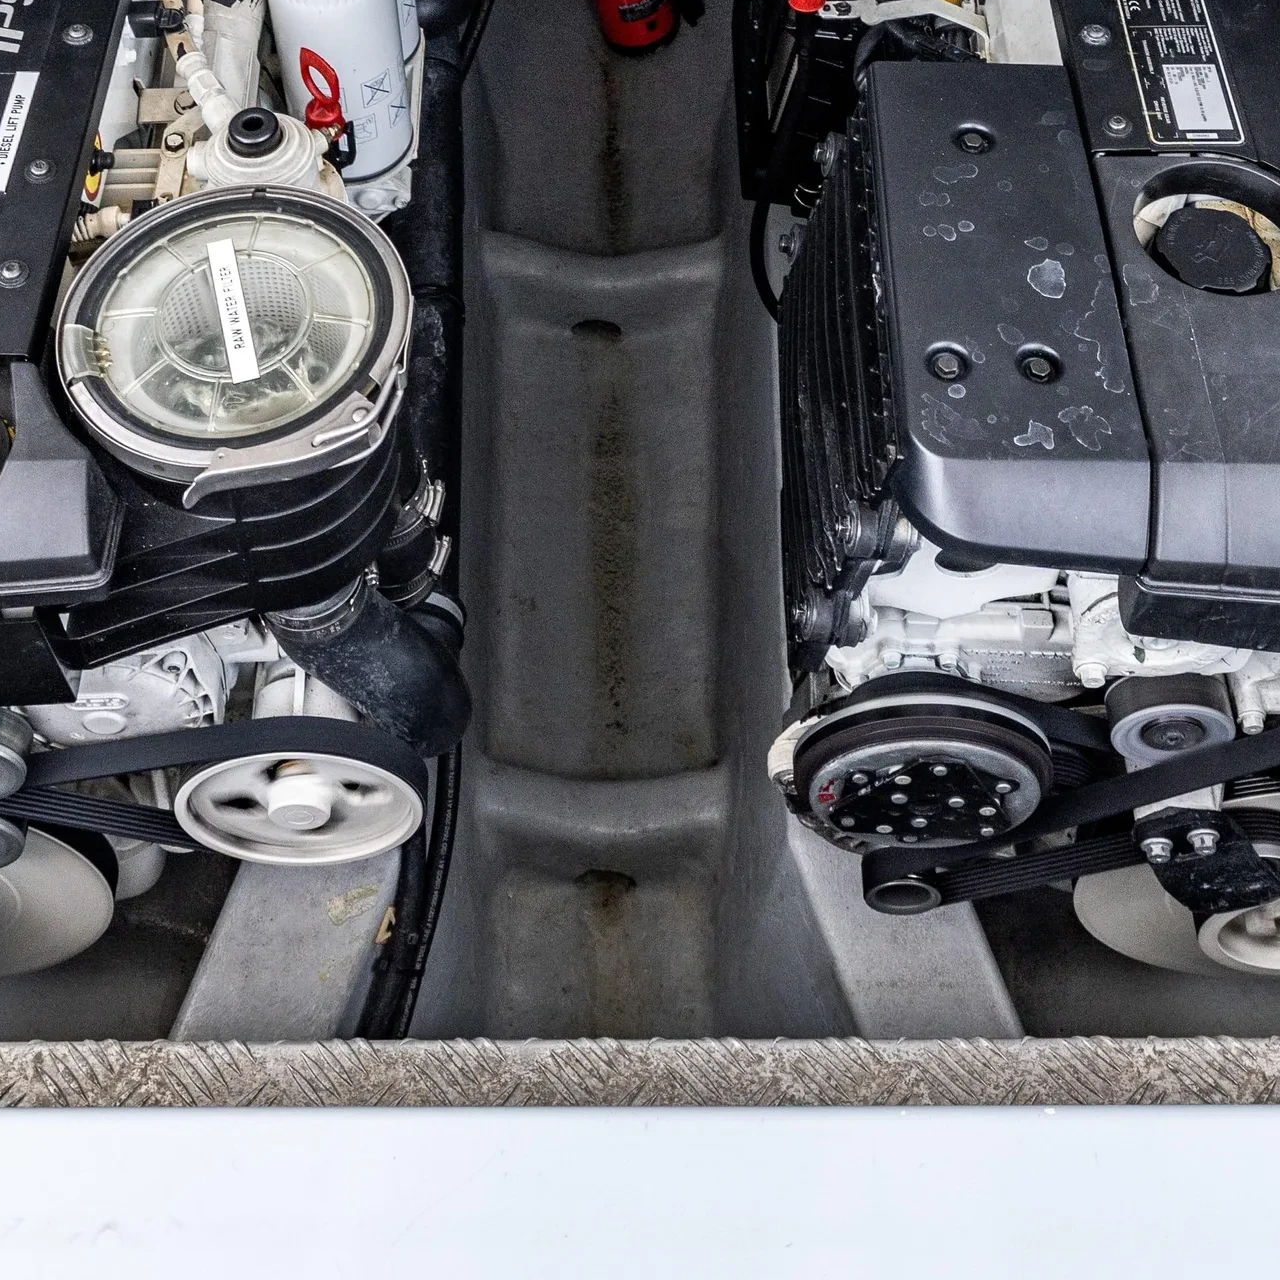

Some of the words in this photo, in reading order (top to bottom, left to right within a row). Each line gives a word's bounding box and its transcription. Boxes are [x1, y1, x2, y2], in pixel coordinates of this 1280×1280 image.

[11, 94, 26, 114] PUMP
[5, 117, 20, 132] LIFT
[219, 266, 234, 292] FILTER
[225, 296, 240, 326] WATER
[231, 328, 246, 350] RAW
